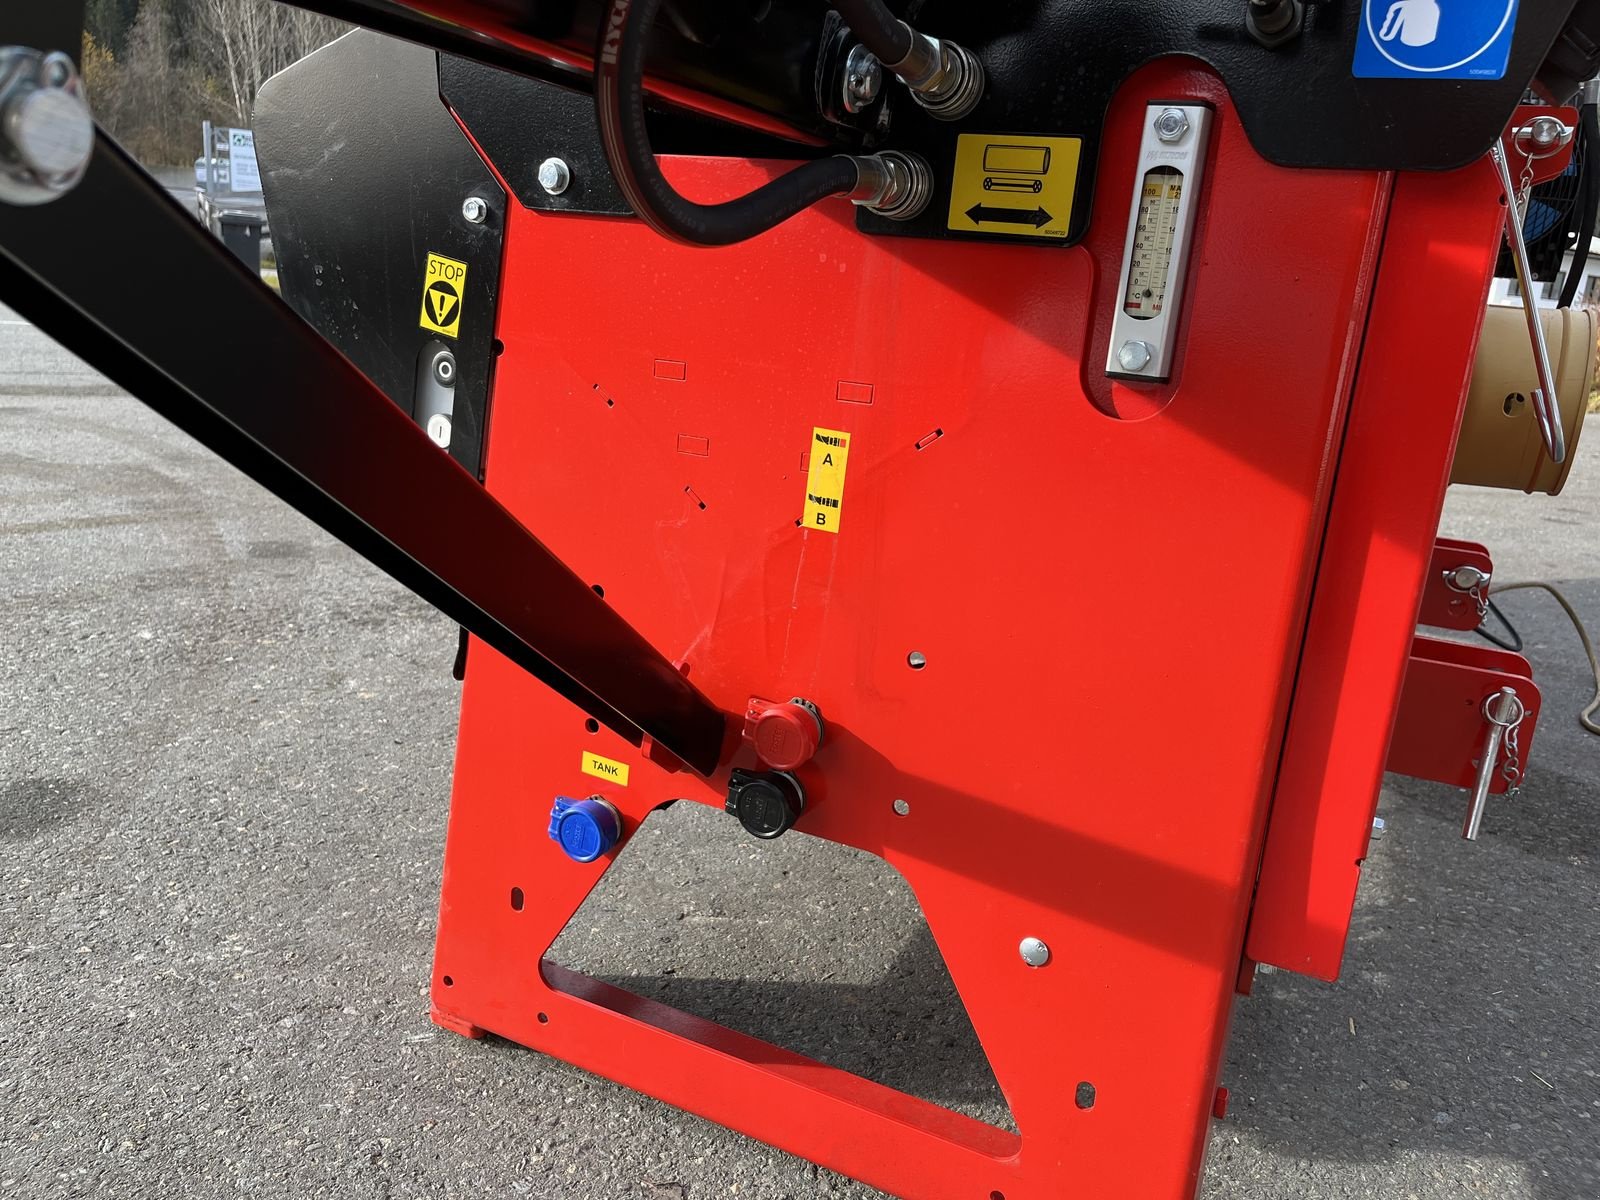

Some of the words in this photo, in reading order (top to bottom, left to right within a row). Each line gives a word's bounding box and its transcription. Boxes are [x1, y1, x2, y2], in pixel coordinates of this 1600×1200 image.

[429, 260, 464, 282] STOP
[822, 453, 833, 466] A
[816, 512, 826, 525] B
[592, 760, 618, 776] TANK
